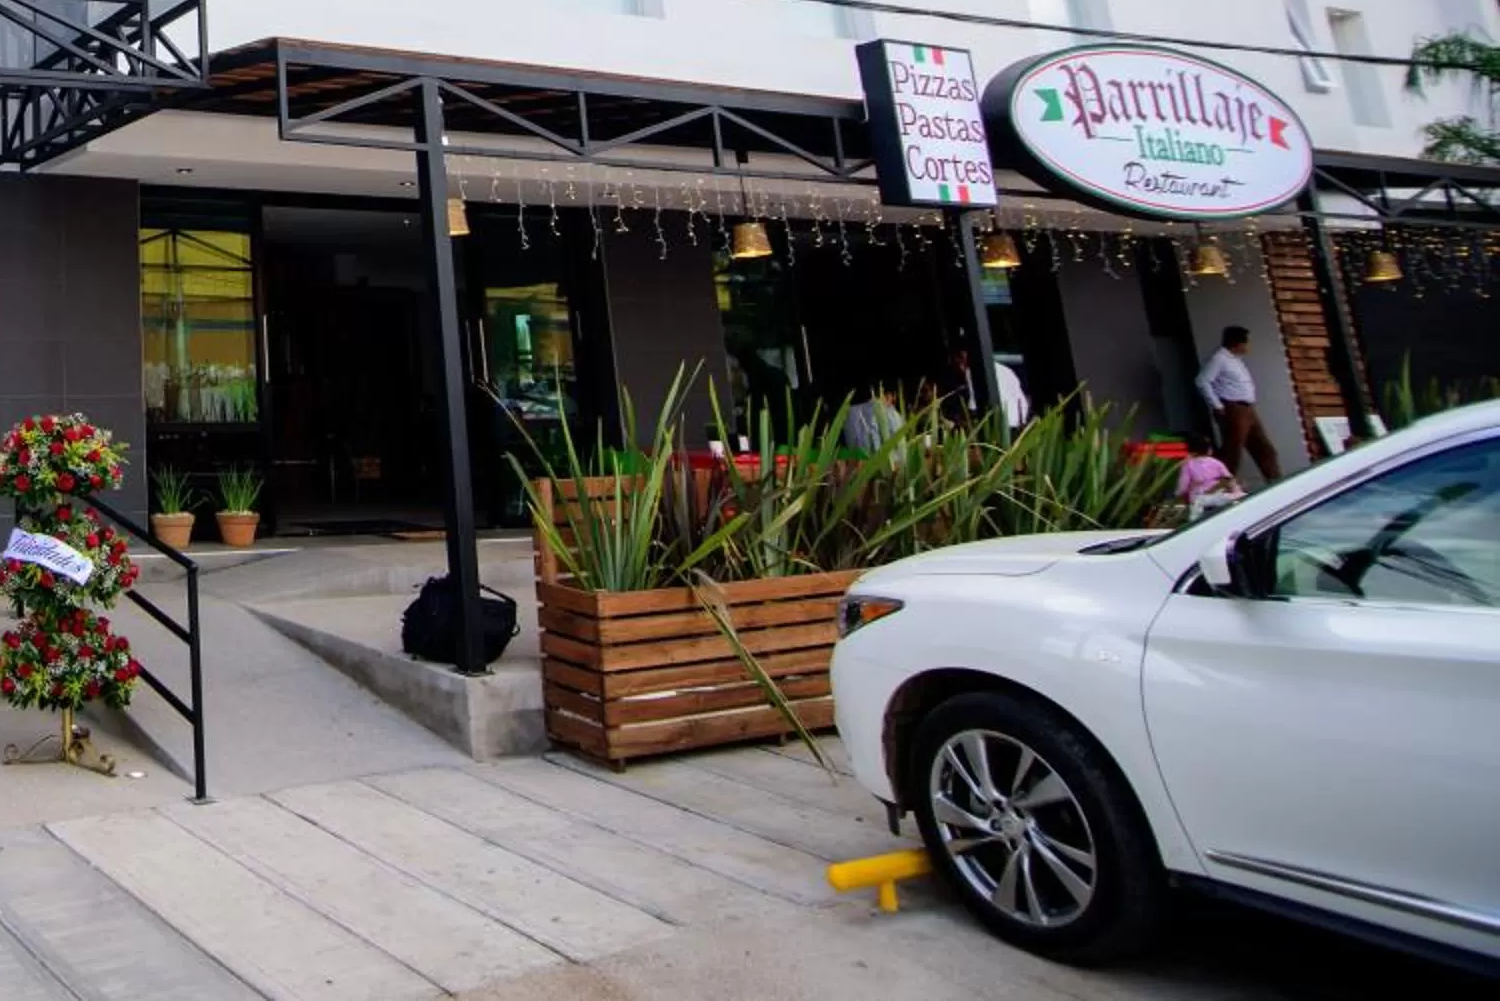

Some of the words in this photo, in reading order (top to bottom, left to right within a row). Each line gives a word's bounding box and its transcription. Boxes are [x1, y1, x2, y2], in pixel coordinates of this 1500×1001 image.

[889, 60, 975, 102] Pizzas
[895, 102, 986, 144] Pastas
[1057, 63, 1268, 145] Parrillaje
[906, 144, 991, 184] Cortes
[1133, 124, 1227, 166] Italiano
